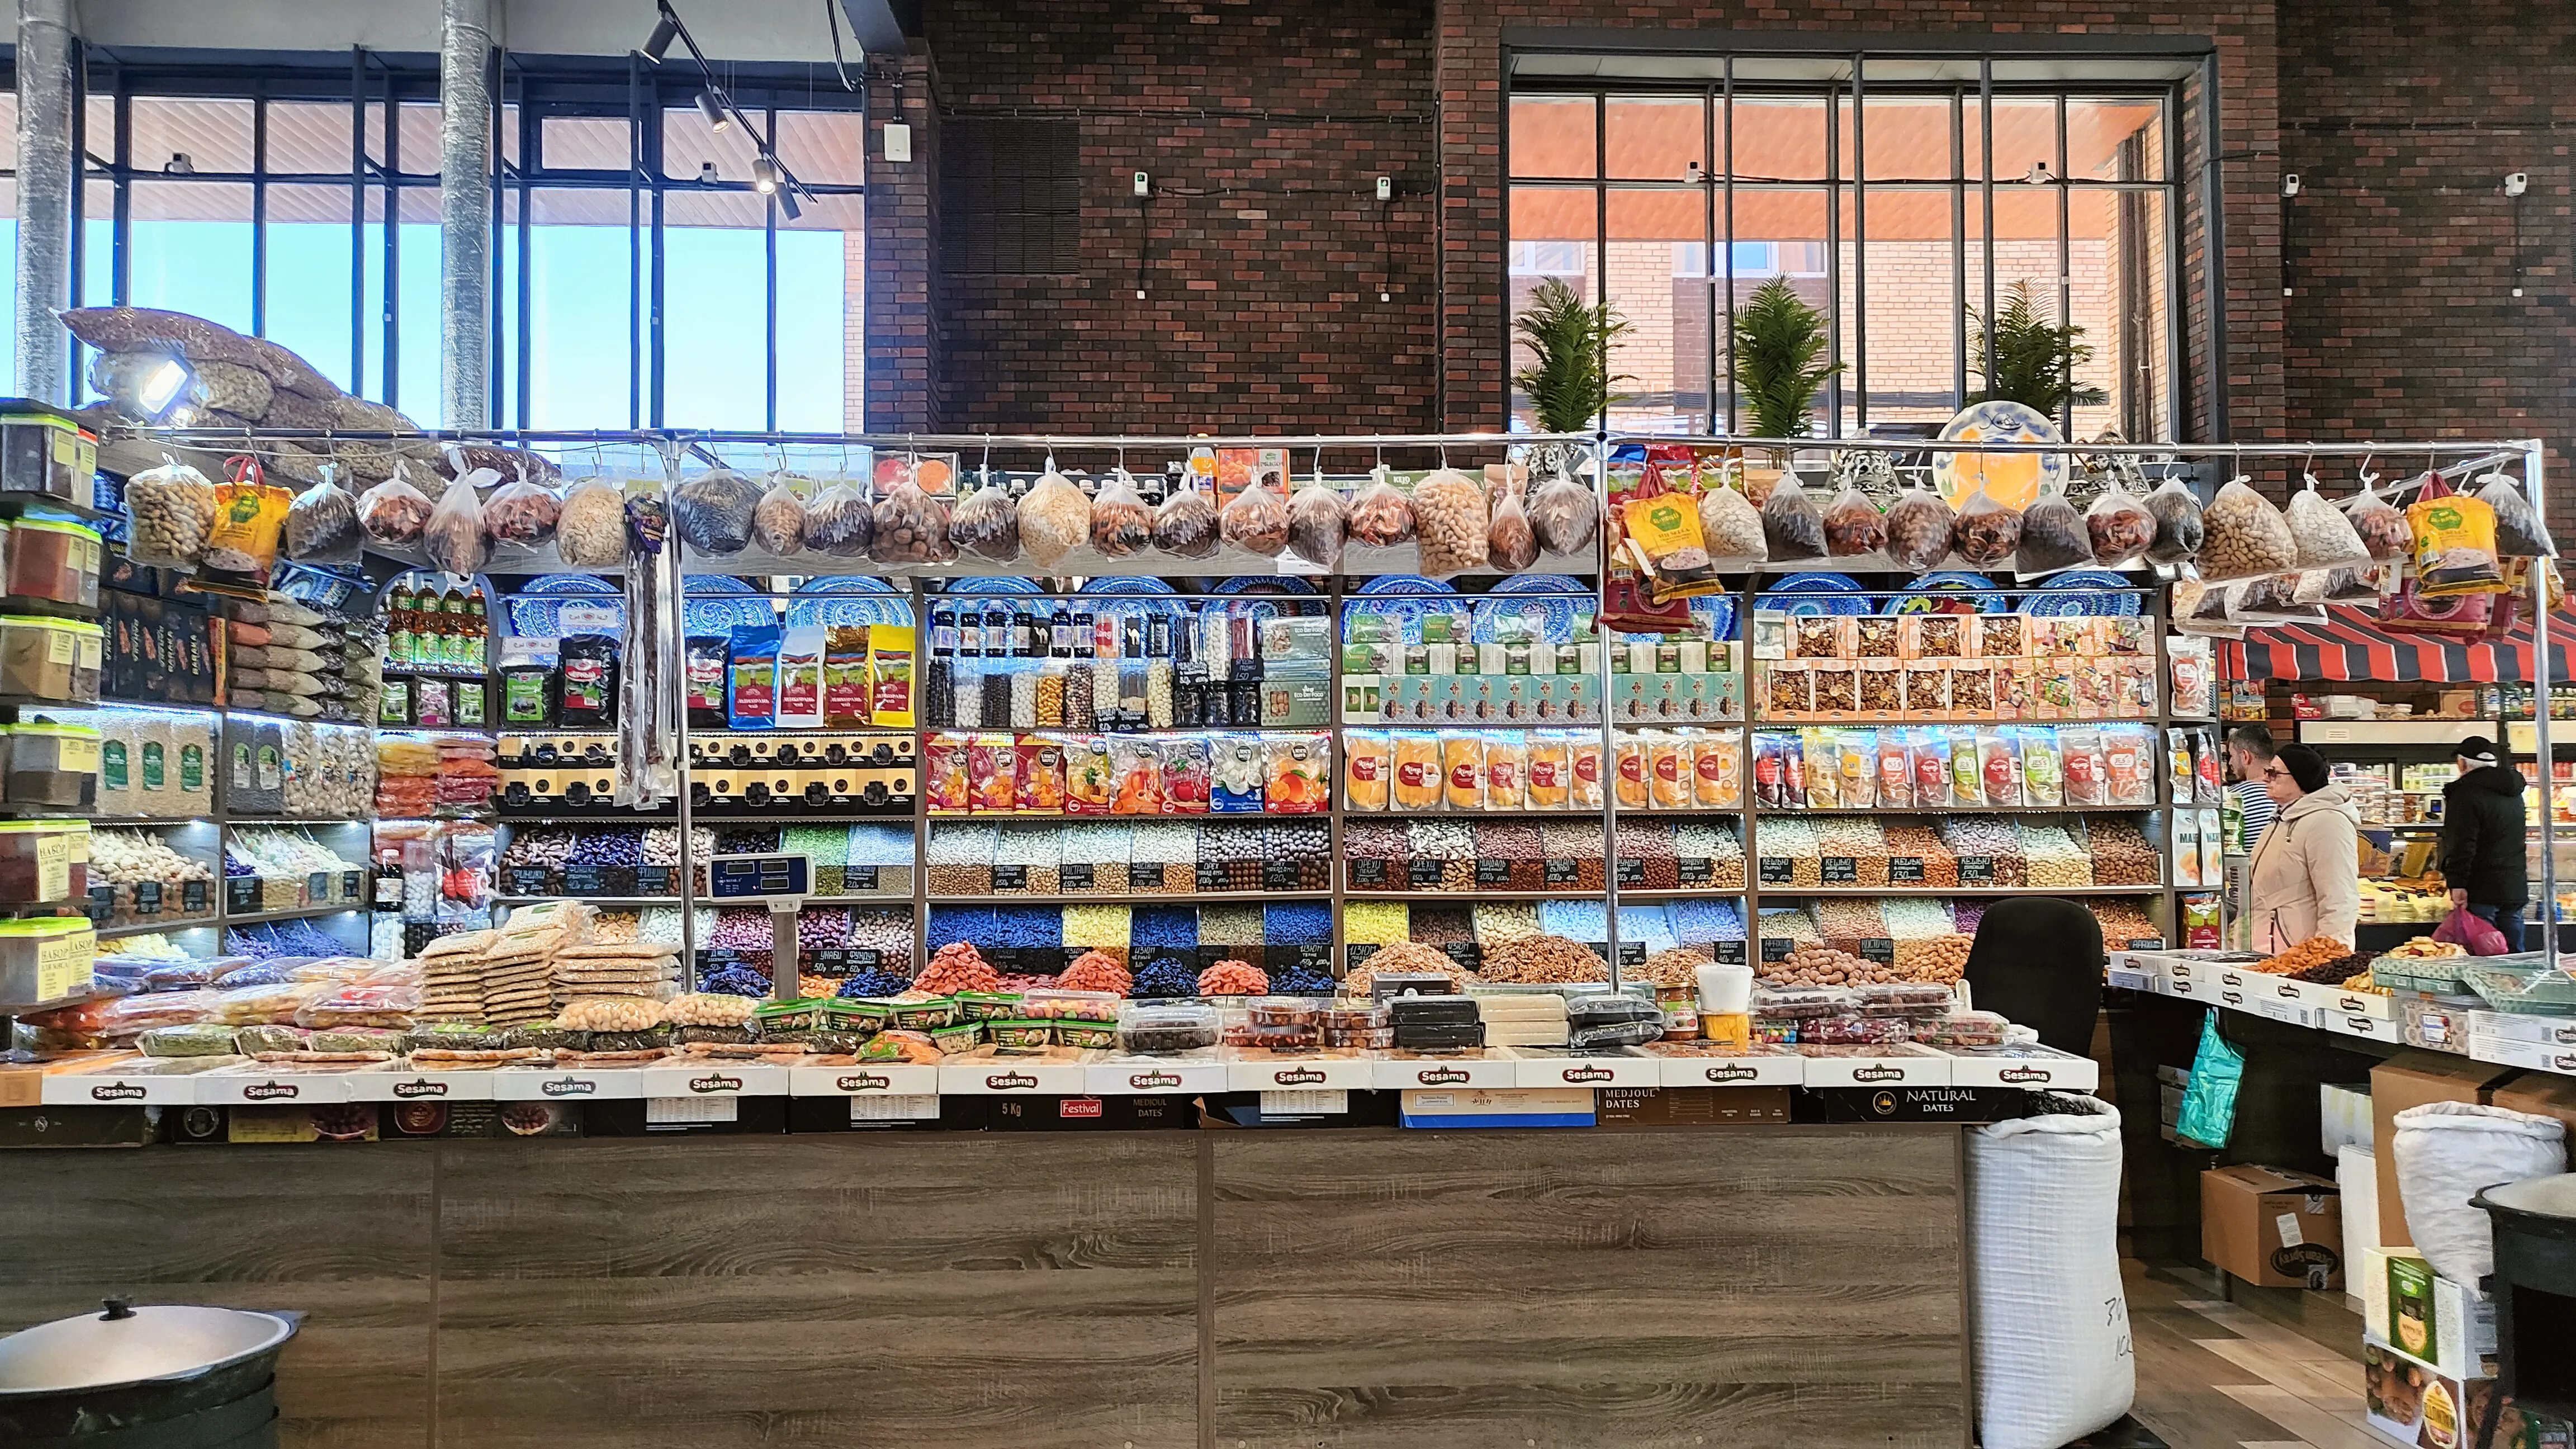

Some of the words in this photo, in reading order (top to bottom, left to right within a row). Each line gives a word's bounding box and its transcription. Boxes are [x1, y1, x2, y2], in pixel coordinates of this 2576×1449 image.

[1393, 476, 1410, 484] KEJO
[1405, 764, 1423, 774] King
[1456, 766, 1475, 776] King
[1535, 765, 1554, 774] King
[39, 844, 66, 857] НАБОР
[1357, 859, 1381, 869] ОРЕХИ
[1413, 859, 1436, 868] ОРЕХИ
[1479, 859, 1506, 867] МИНДАЛЬ
[1546, 859, 1576, 867] МИНДАЛЬ
[1680, 858, 1706, 866] ФУНДУК
[1825, 858, 1852, 866] КЕШЬЮ
[513, 870, 546, 879] ФИНИКИ
[637, 867, 667, 877] ФИНИКИ
[1062, 865, 1093, 875] ФИСТАШКИ
[1861, 939, 1893, 949] КОСТОЧКИ
[1349, 945, 1377, 955] ИЗЮМ
[820, 951, 842, 960] УНАБИ
[849, 951, 876, 960] ФУНДУК
[1277, 1071, 1323, 1082] Sesama
[1422, 1070, 1467, 1081] Sesama
[1566, 1069, 1611, 1080] Sesama
[1710, 1069, 1754, 1079] Sesama
[1857, 1068, 1902, 1079] Sesama
[2003, 1070, 2048, 1081] Sesama
[693, 1078, 740, 1089] Sesama
[840, 1076, 887, 1087] Sesama
[989, 1076, 1035, 1087] Sesama
[1132, 1075, 1178, 1086] Sesama
[96, 1086, 144, 1097] Sesama
[247, 1086, 295, 1097] Sesama
[397, 1083, 445, 1095] Sesama
[546, 1081, 593, 1093] Sesama
[1606, 1089, 1656, 1098] MEDJOUL
[1906, 1089, 1977, 1104] NATURAL
[1133, 1097, 1167, 1107] MEDJOUL
[1606, 1100, 1640, 1109] DATES
[1002, 1102, 1008, 1115] 5
[1010, 1102, 1021, 1117] Kg
[1063, 1102, 1100, 1115] Festival
[1138, 1109, 1163, 1118] DATES
[1923, 1104, 1954, 1113] DATES
